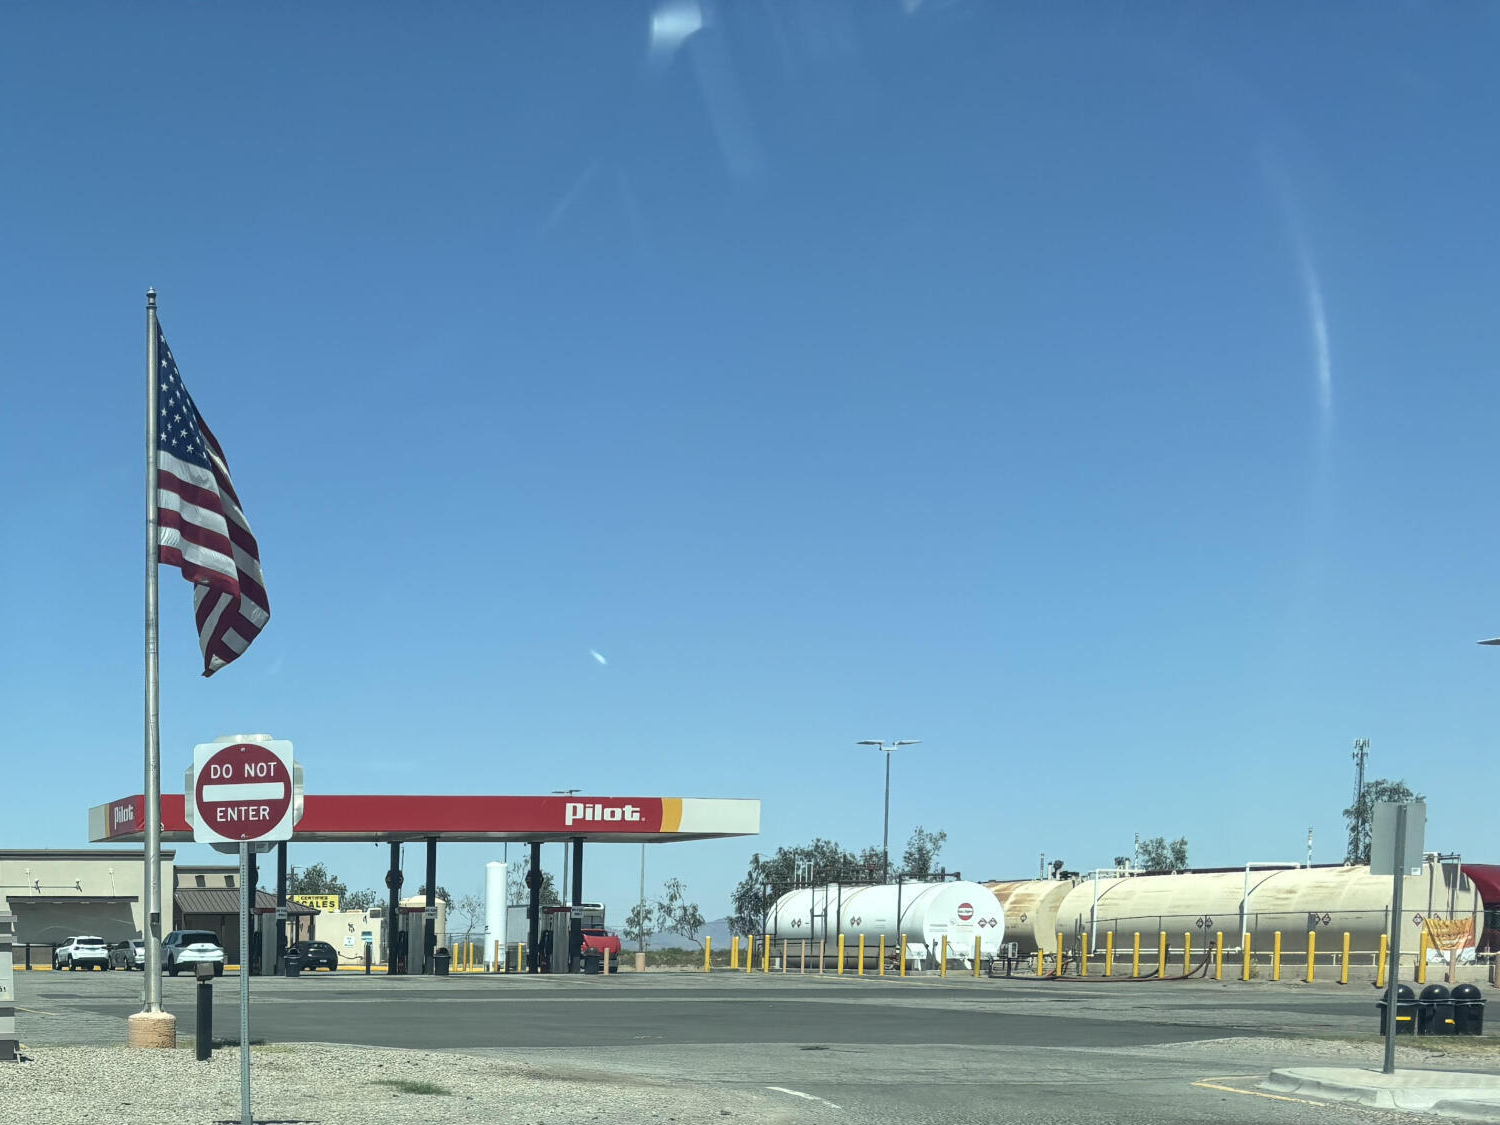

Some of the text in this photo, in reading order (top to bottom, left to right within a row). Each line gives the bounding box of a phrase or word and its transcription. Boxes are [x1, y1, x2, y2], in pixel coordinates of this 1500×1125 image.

[210, 762, 277, 779] DO NOT
[113, 804, 135, 830] Pilot
[216, 805, 270, 822] ENTER
[565, 802, 641, 826] Pilot
